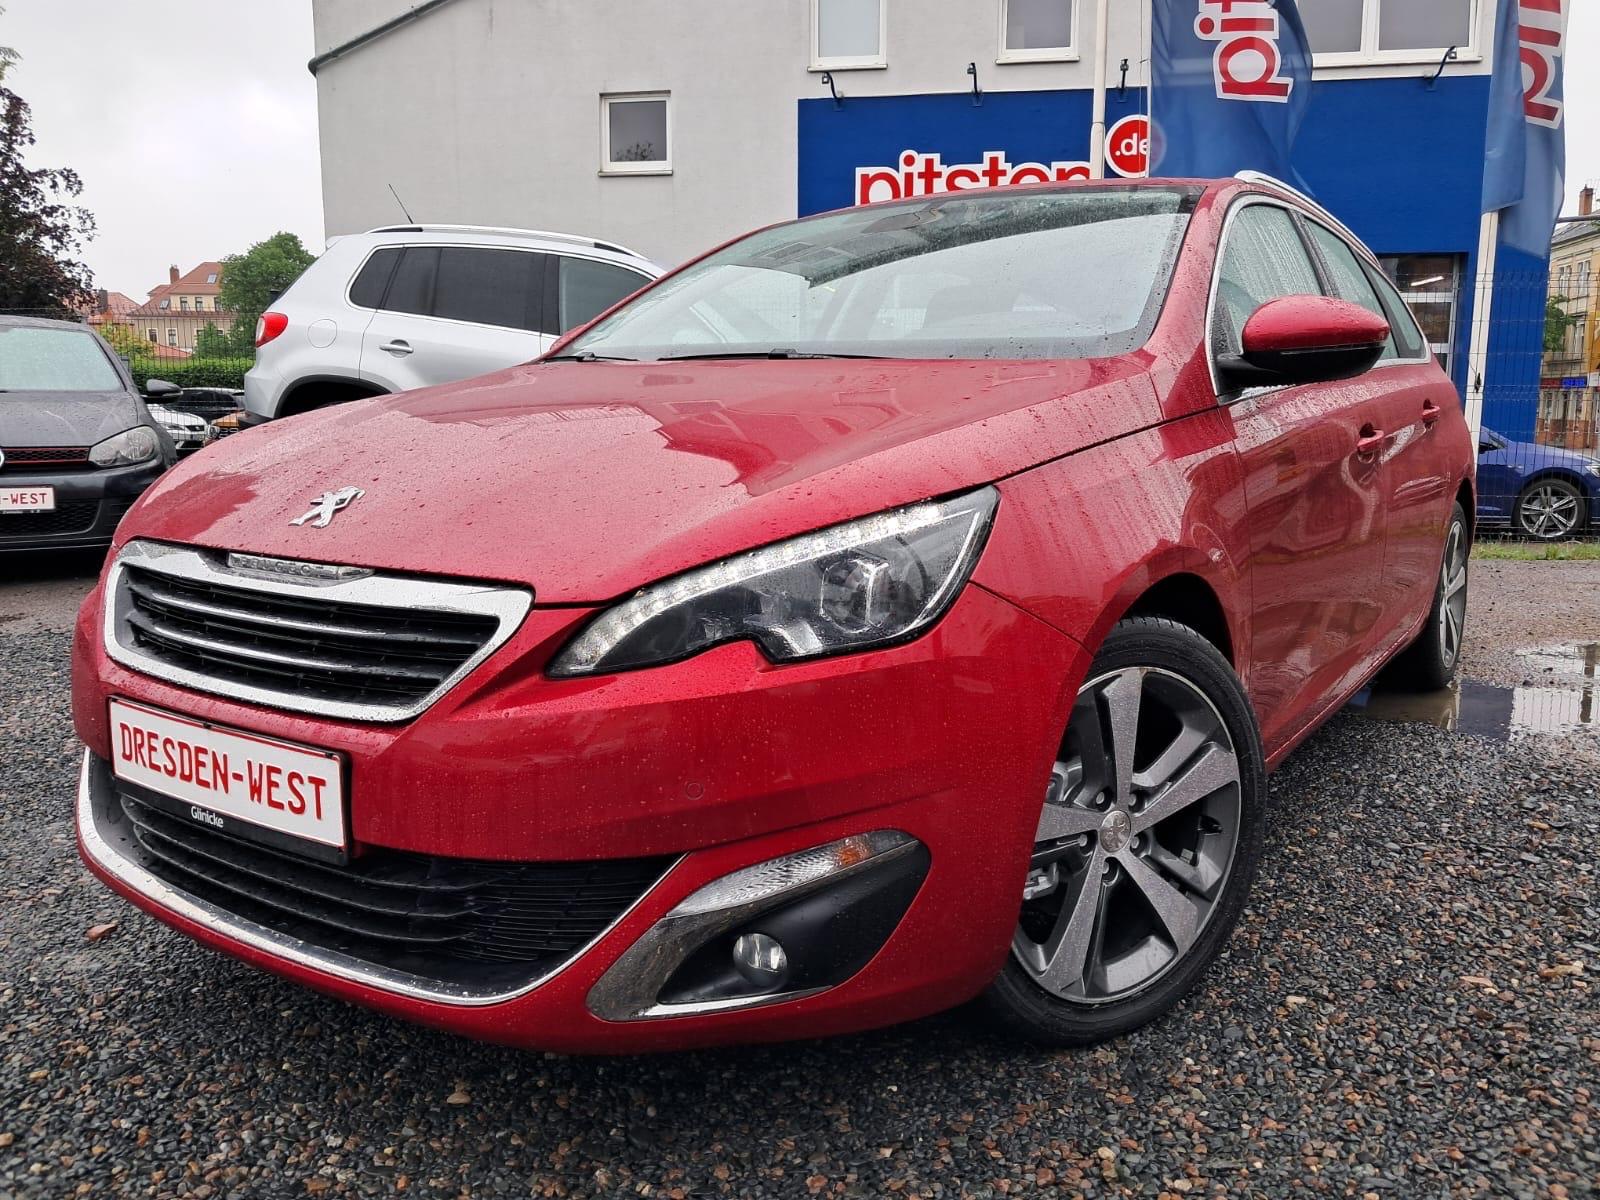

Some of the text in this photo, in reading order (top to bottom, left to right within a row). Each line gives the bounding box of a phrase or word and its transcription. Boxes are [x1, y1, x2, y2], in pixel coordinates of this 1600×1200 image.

[859, 154, 1091, 206] pitst
[0, 492, 47, 505] -WEST
[119, 722, 327, 820] DRESDEN-WEST
[190, 805, 224, 828] Glinicke
